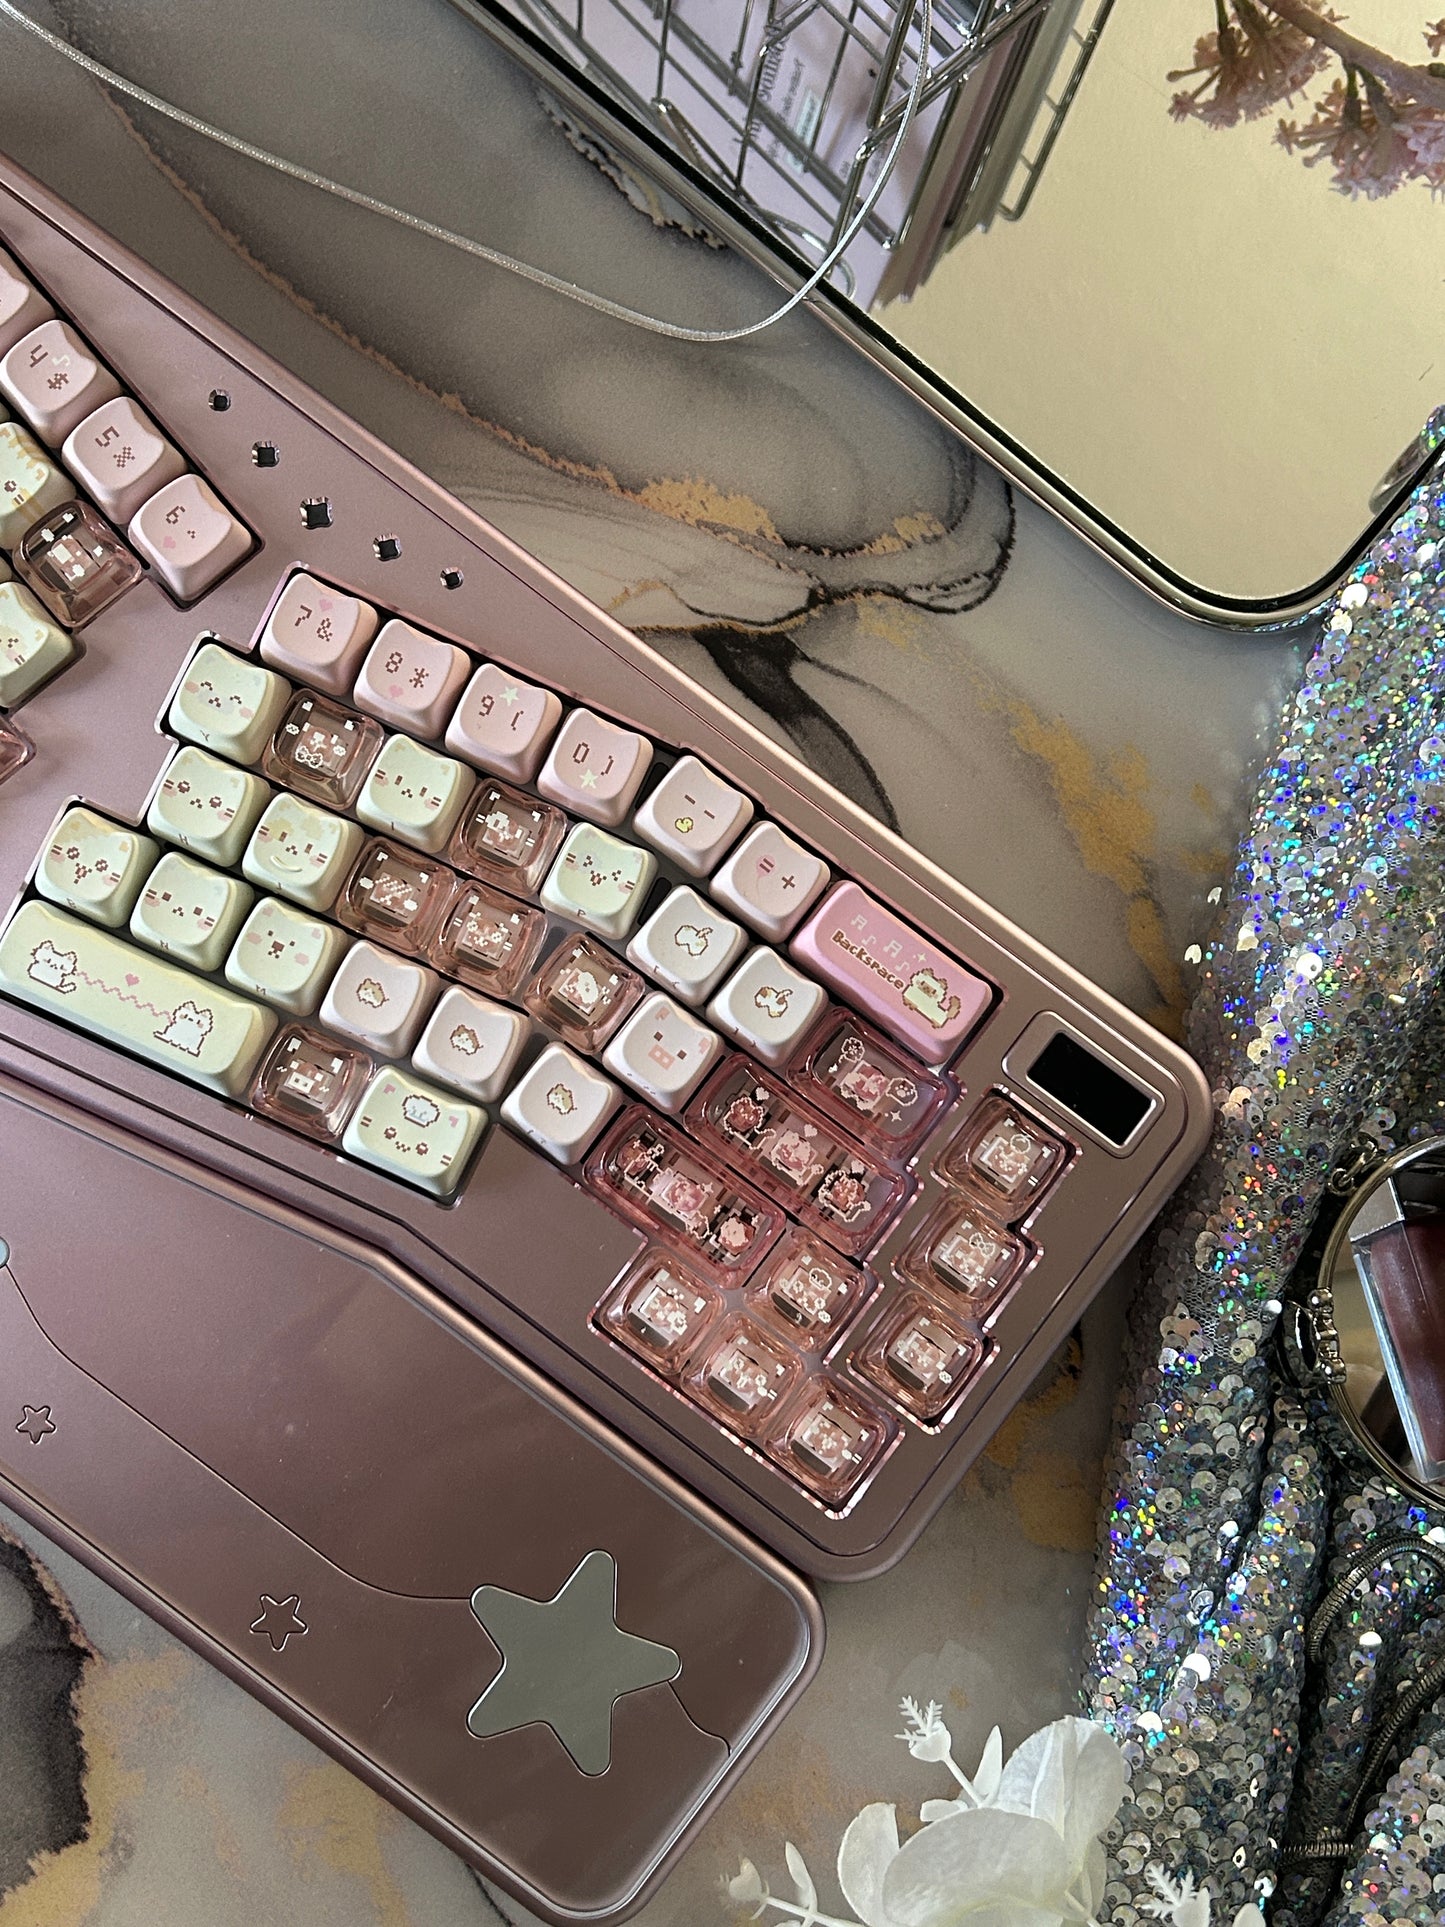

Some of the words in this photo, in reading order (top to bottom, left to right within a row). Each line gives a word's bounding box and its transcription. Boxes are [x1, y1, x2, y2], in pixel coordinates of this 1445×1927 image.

[30, 344, 49, 368] 4
[95, 426, 120, 448] 5
[165, 505, 186, 525] 6
[294, 604, 313, 627] 7
[316, 618, 333, 642] &
[385, 651, 403, 674] 8
[479, 694, 495, 717] 9
[781, 875, 796, 890] +
[831, 930, 904, 990] Backspace
